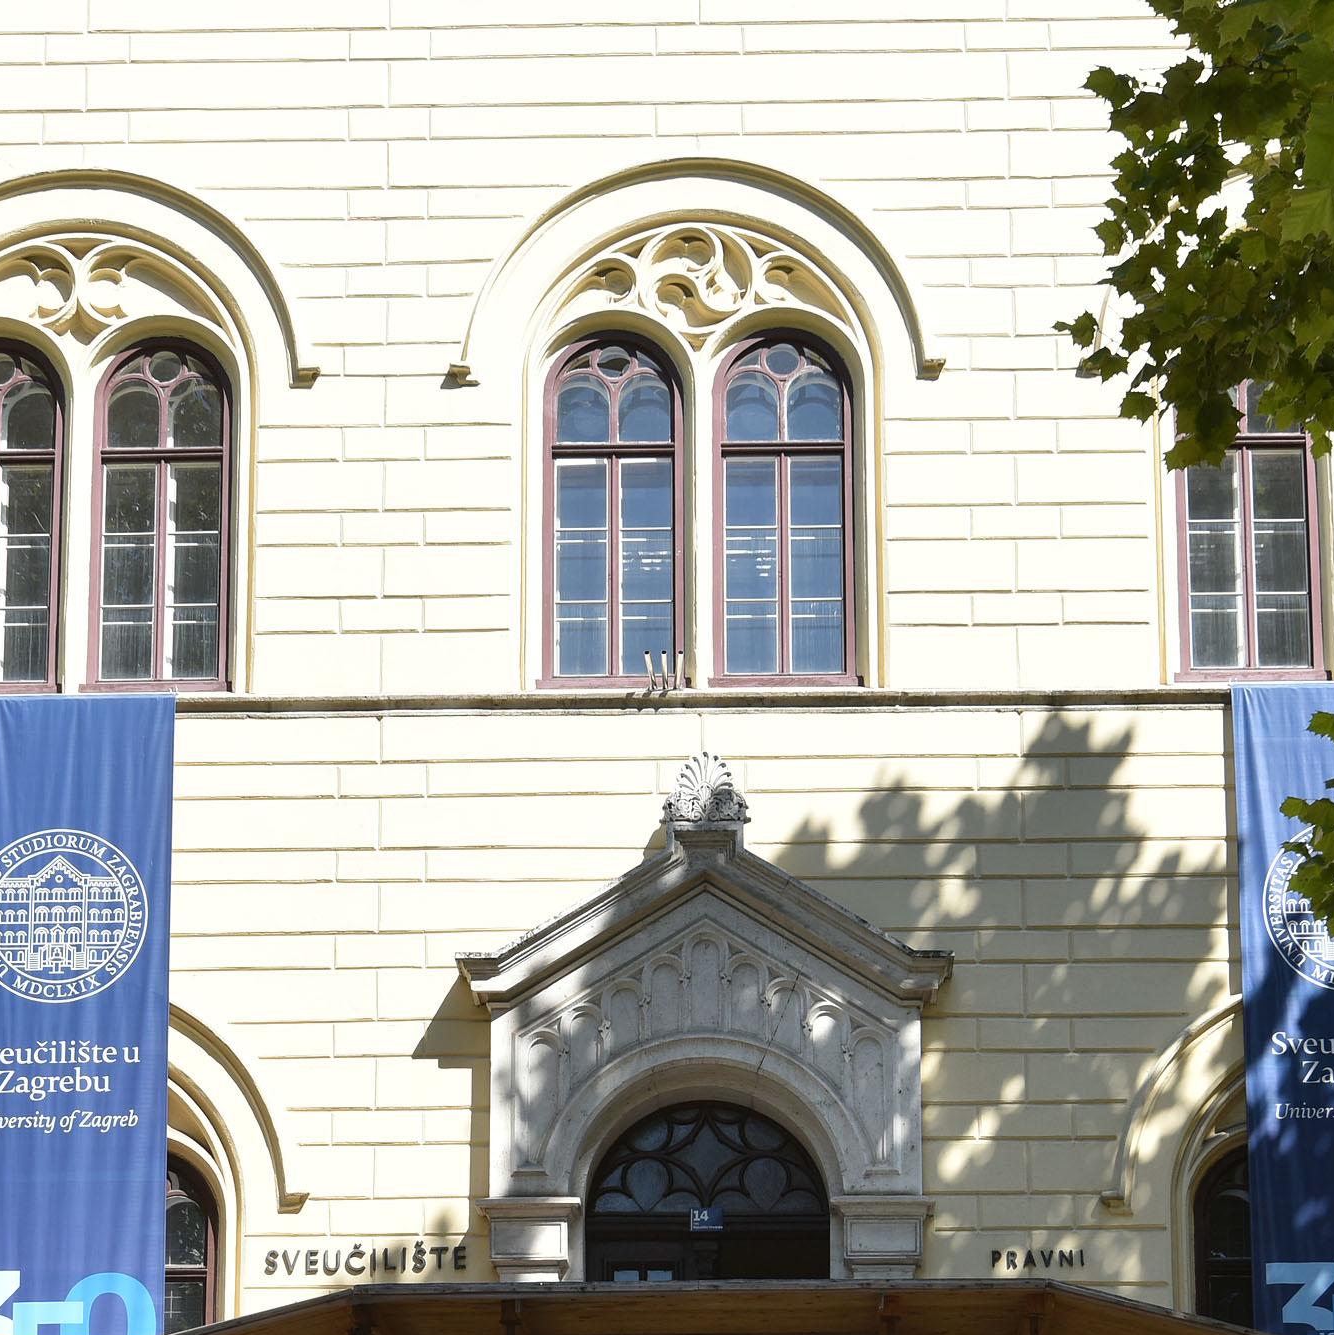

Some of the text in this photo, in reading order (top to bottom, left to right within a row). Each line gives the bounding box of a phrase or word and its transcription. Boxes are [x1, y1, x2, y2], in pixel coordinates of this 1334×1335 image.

[0, 834, 107, 868] STUDIORUM
[105, 854, 143, 976] ZAGRABIENSIS
[1268, 856, 1307, 968] UNIVERSITAS
[12, 974, 102, 998] MDCLXIX
[122, 1046, 141, 1063] u
[59, 1110, 80, 1133] of
[78, 1109, 139, 1133] Zagreb
[693, 1210, 709, 1221] 14
[264, 1240, 466, 1276] SVEUČILIŠTE
[991, 1249, 1085, 1270] PRAVNI
